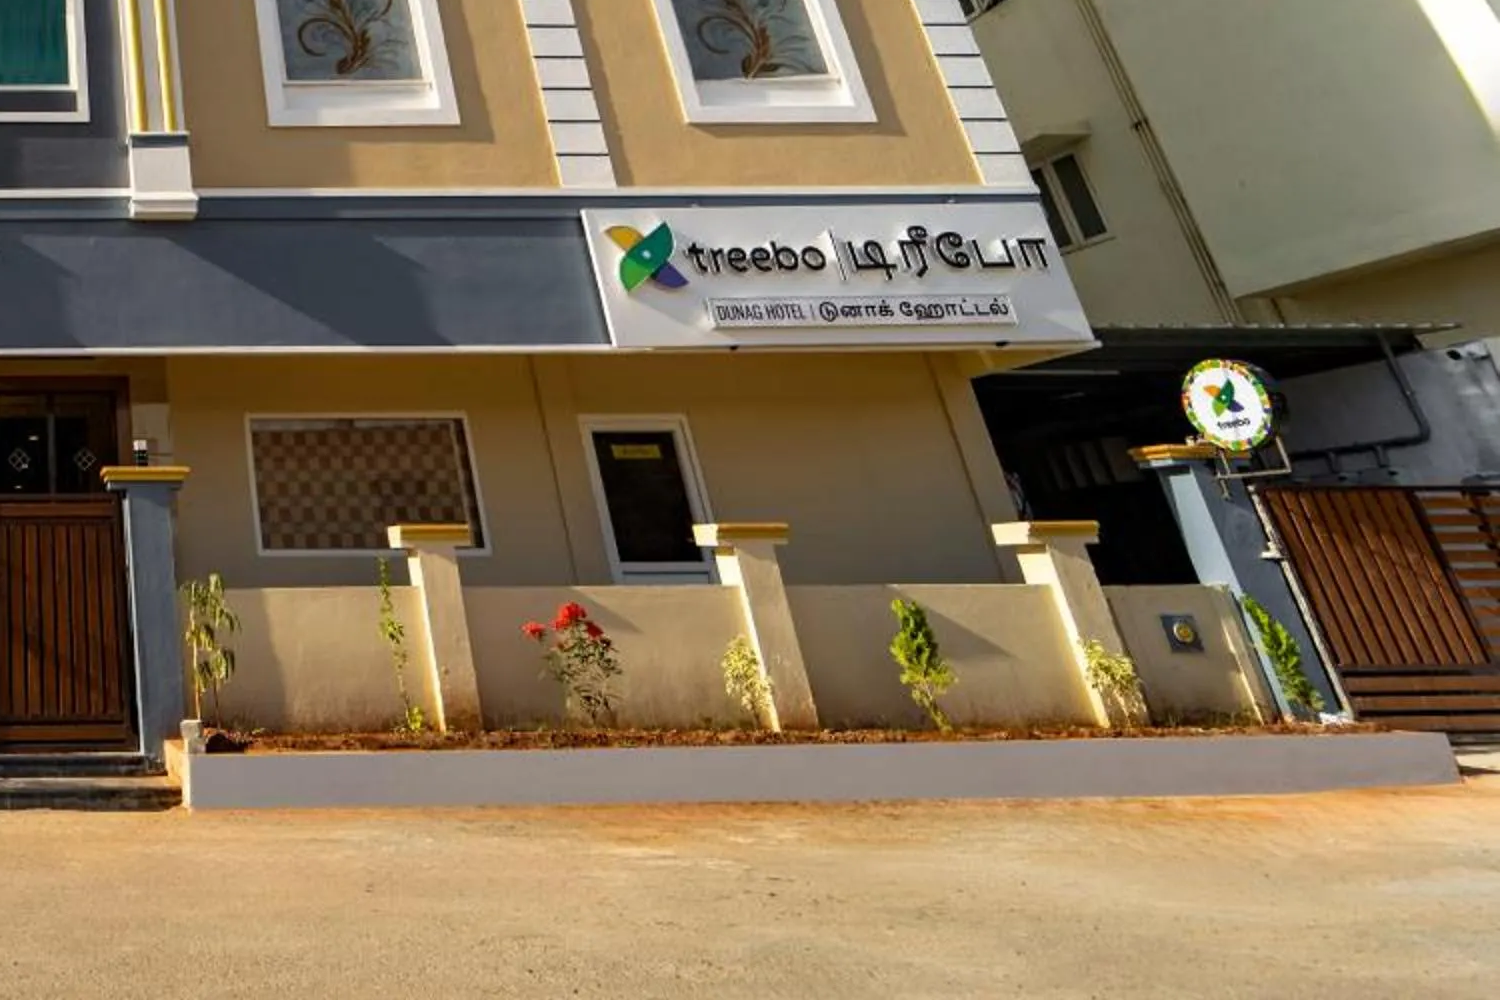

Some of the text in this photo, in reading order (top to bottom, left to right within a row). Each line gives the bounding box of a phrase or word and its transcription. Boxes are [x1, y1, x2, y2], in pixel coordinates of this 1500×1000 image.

[686, 241, 827, 274] treebo
[847, 225, 1049, 282] டிரீபோ
[716, 303, 805, 321] DUNAG HOTEL
[818, 297, 1010, 323] டுனாக் ஹோட்டல்
